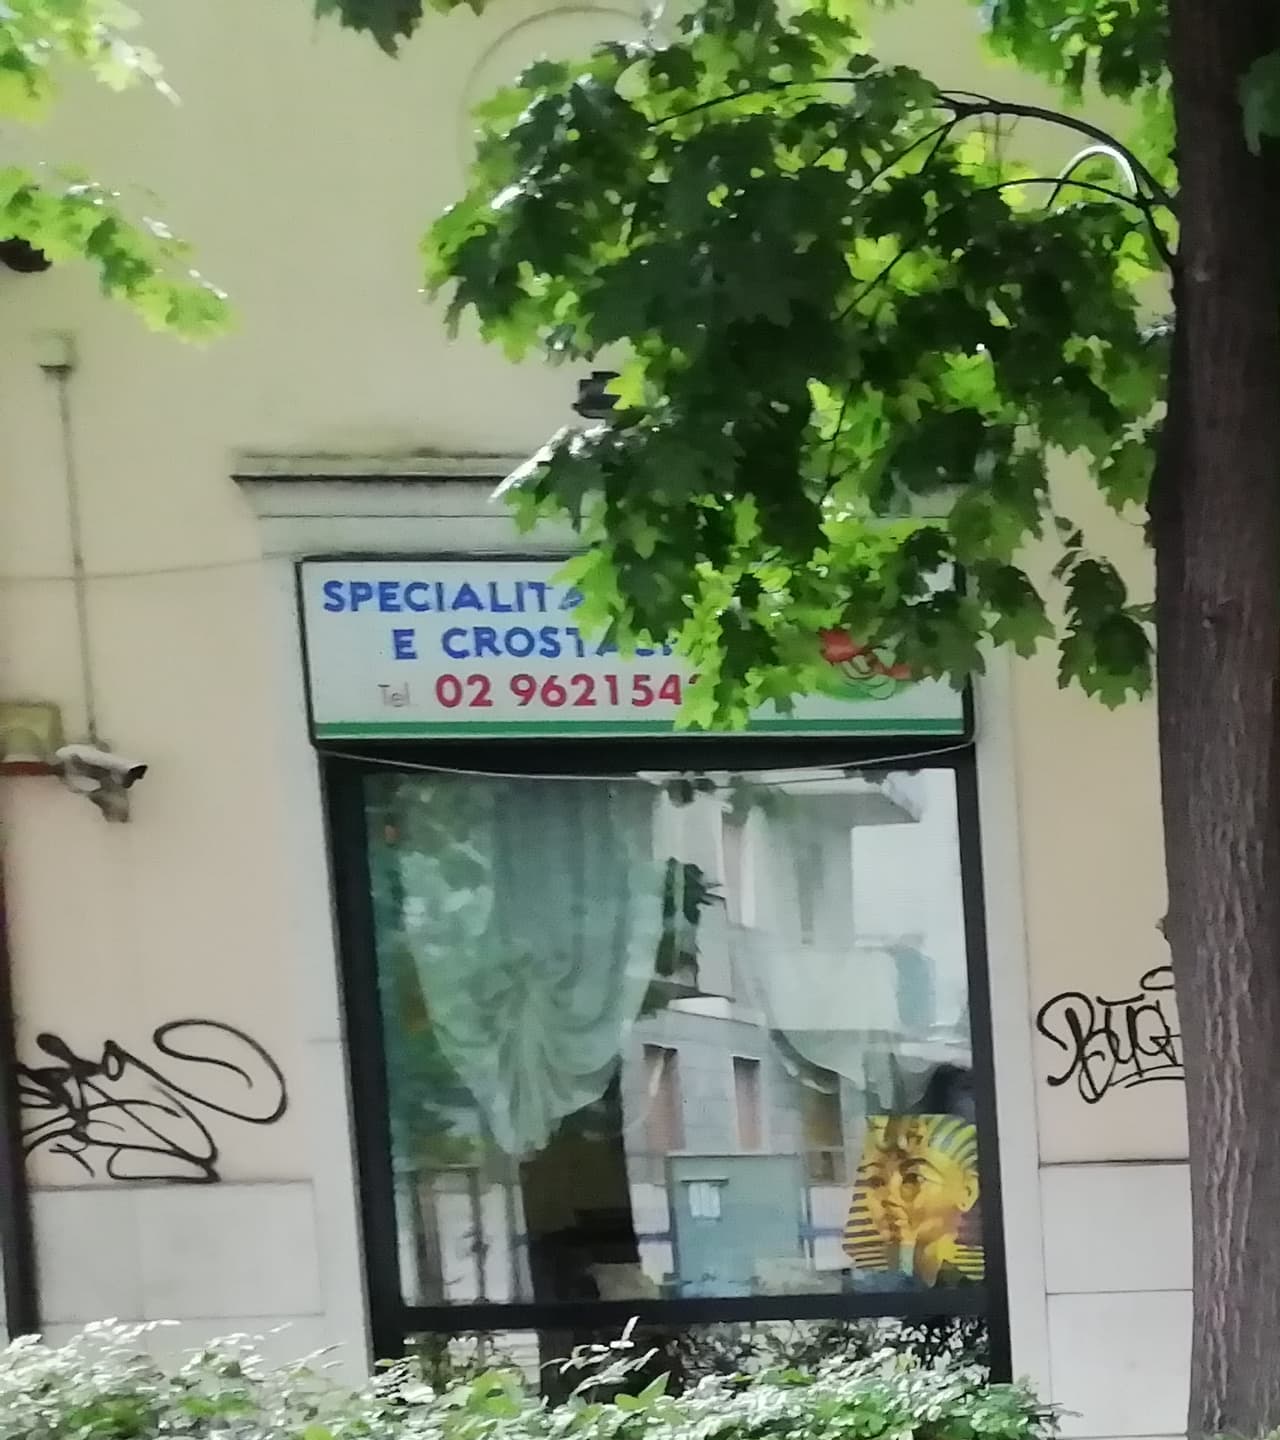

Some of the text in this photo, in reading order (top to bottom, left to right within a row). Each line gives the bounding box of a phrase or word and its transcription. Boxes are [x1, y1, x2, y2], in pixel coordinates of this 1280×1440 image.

[391, 629, 417, 660] E
[435, 674, 493, 708] 02
[511, 673, 702, 708] 962154
